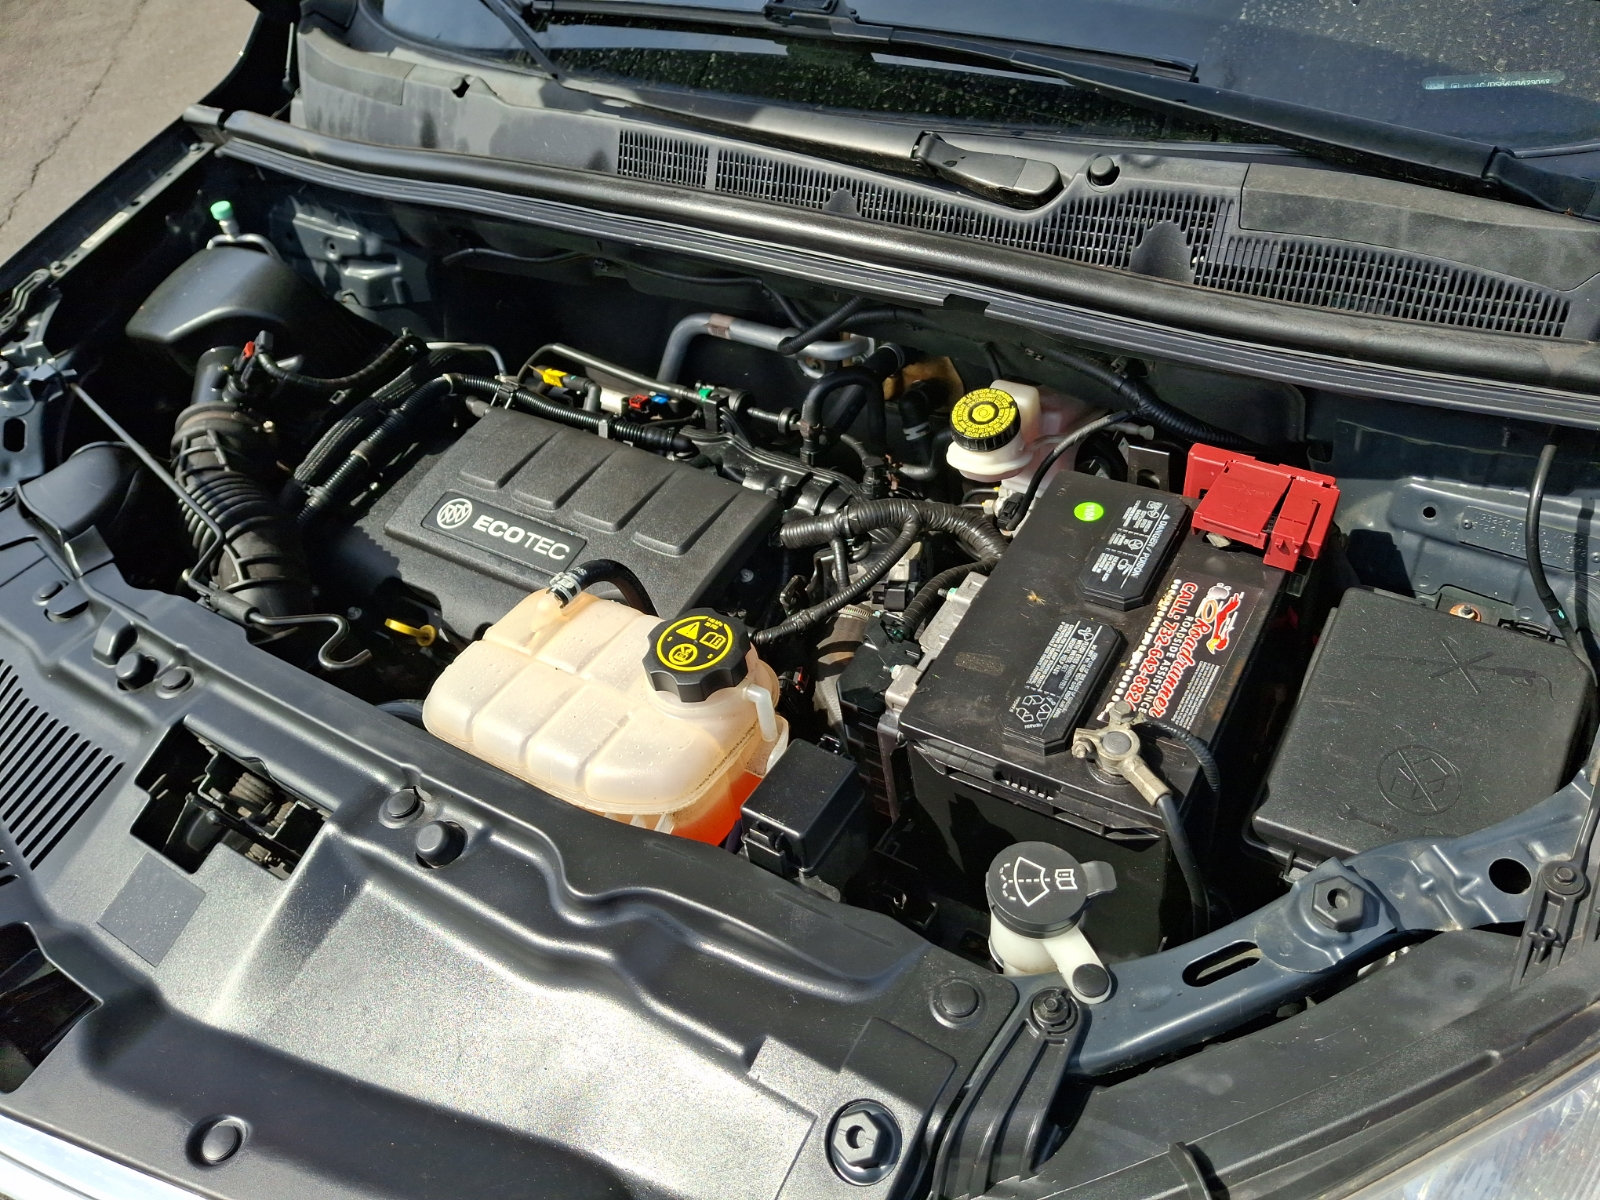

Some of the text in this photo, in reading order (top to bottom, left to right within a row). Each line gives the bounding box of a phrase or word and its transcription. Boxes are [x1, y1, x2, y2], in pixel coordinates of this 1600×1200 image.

[472, 515, 570, 560] ECOTEC
[1148, 520, 1168, 547] DANGER
[1167, 582, 1198, 620] CALL:
[1124, 620, 1179, 711] 732-642-882
[1138, 615, 1194, 714] ROADSIDE ASSISTANCE
[1149, 617, 1212, 718] Roadrunner
